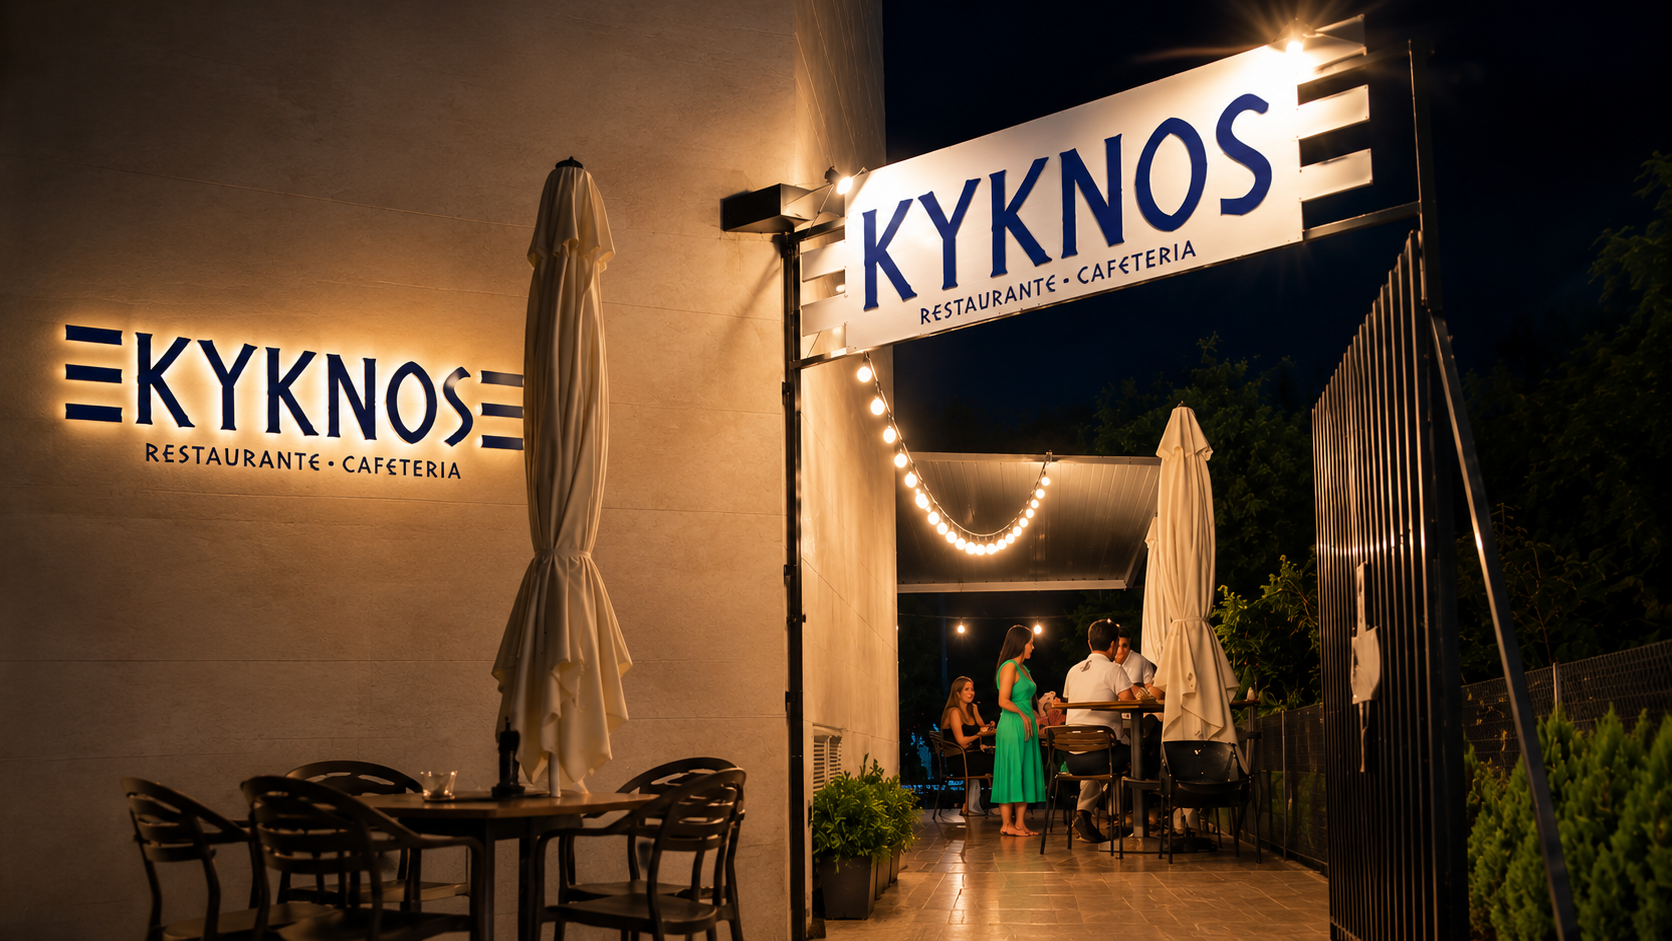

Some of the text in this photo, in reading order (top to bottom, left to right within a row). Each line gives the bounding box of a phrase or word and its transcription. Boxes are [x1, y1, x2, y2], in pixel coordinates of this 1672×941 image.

[862, 93, 1273, 311] KYKNOS
[920, 240, 1197, 325] RESTAURANTE CAFETERIA
[134, 331, 474, 447] KYKNOS
[145, 442, 461, 479] RESTAURANTE CAFETERIA
